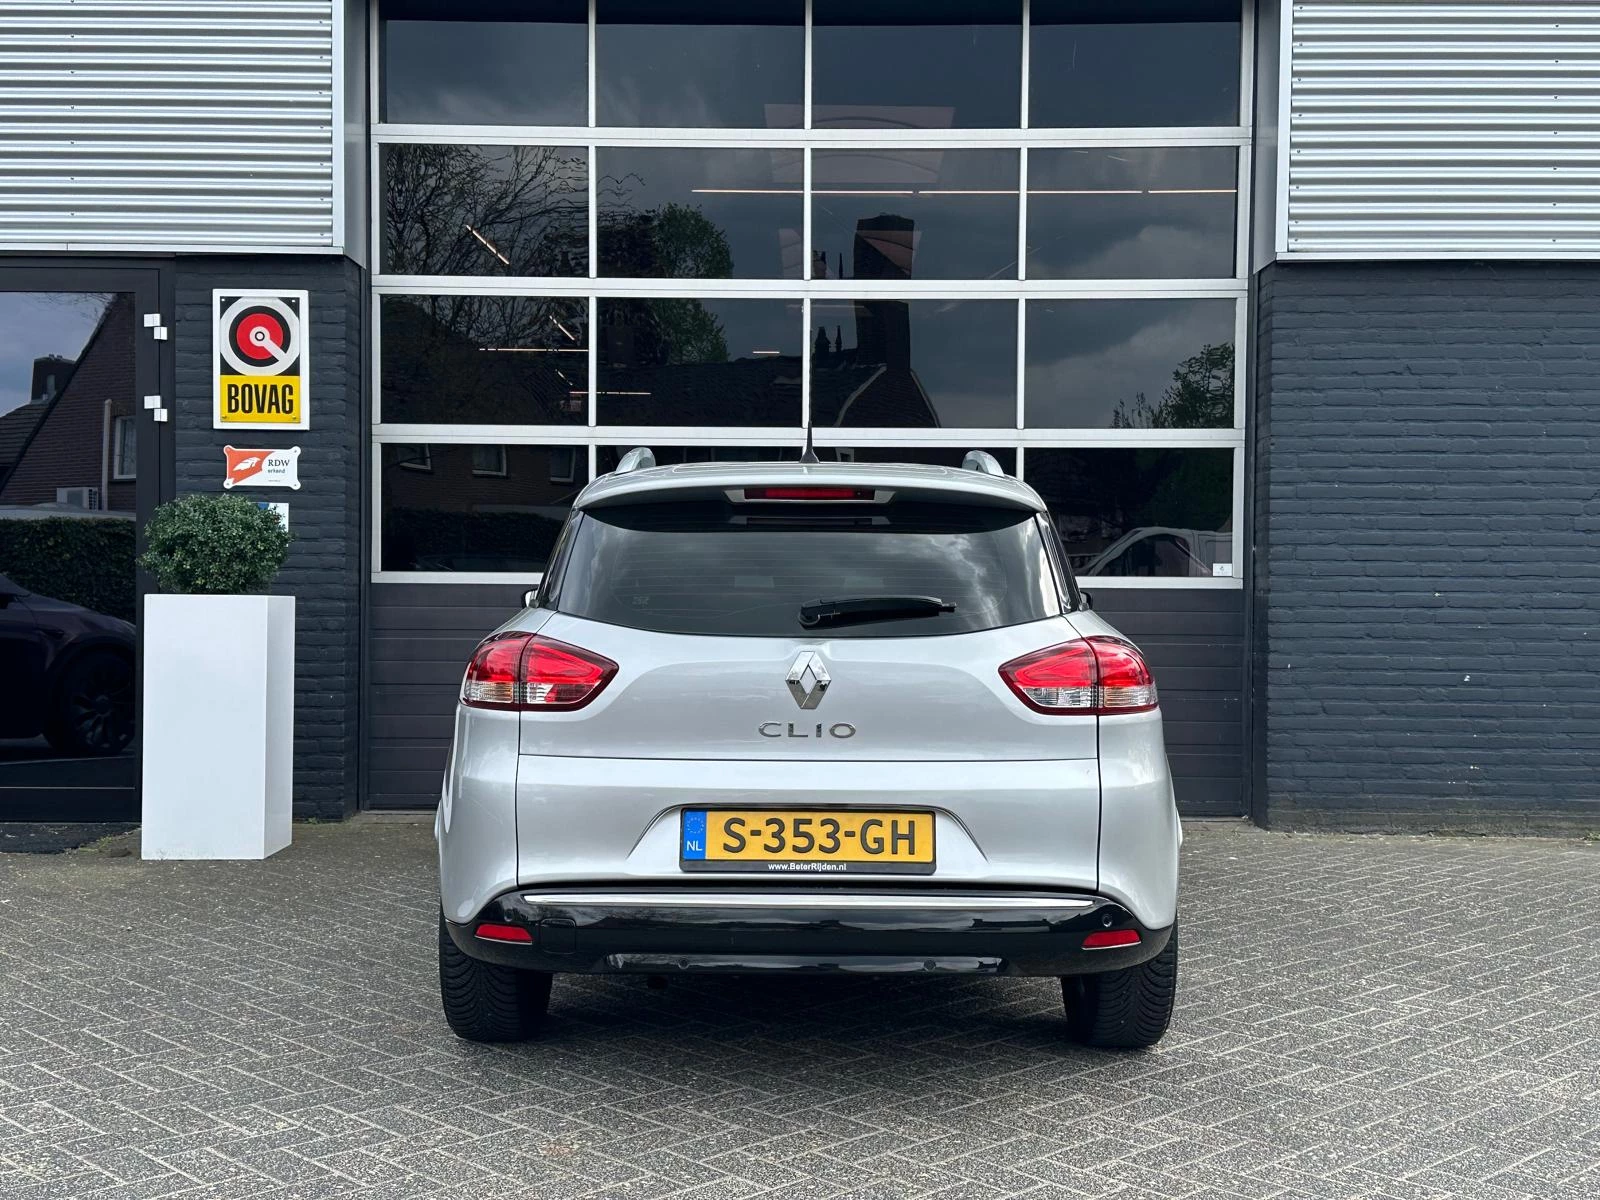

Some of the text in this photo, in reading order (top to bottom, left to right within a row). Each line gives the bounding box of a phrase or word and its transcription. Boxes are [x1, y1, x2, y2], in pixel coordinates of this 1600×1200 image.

[227, 383, 294, 414] BOVAG
[268, 459, 290, 467] RDW
[758, 721, 857, 739] CLIO
[723, 817, 915, 855] S-353-GH
[686, 840, 703, 852] NL
[767, 862, 847, 872] www.BeterRijden.nl
